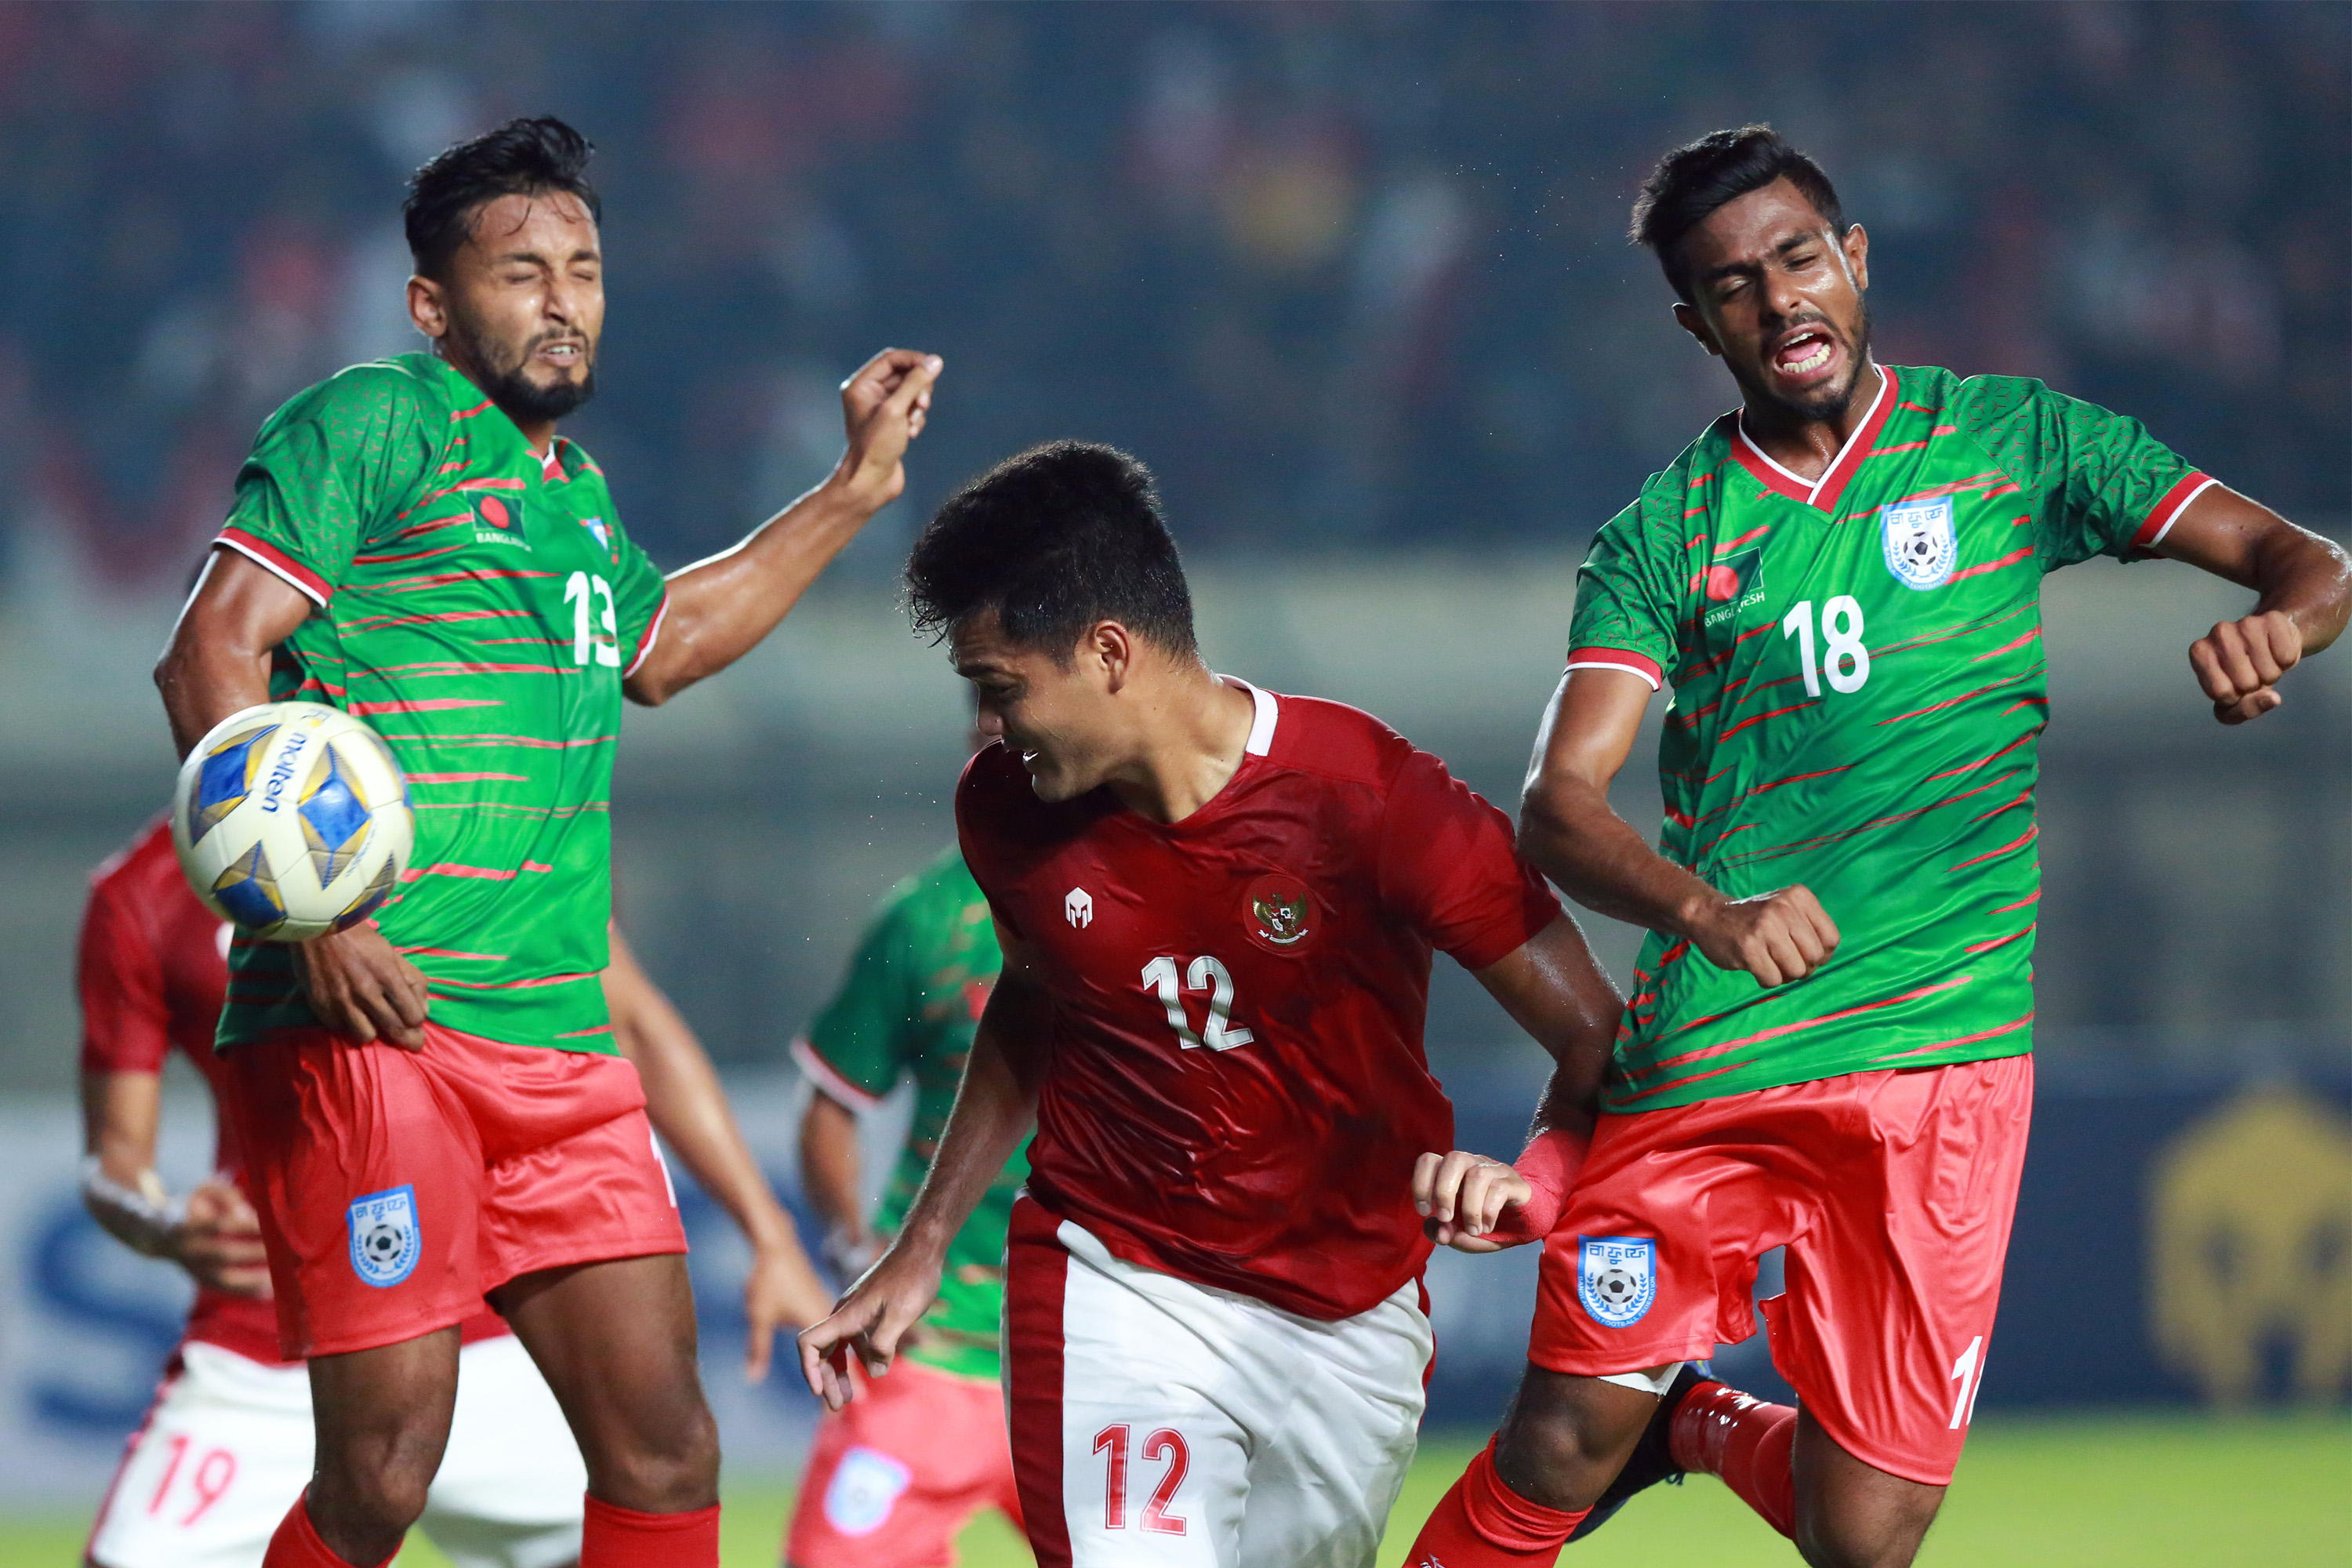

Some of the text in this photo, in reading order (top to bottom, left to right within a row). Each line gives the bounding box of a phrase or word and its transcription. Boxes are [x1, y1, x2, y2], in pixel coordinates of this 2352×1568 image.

[564, 571, 622, 667] 13
[1783, 594, 1871, 698] 18
[260, 732, 308, 813] molten
[1141, 955, 1254, 1051] 12
[1601, 1314, 1639, 1327] FOOTBALL
[1639, 1276, 1656, 1318] FEDERATION
[1949, 1335, 1986, 1430] 1
[149, 1435, 237, 1527] 19
[1093, 1423, 1190, 1537] 12
